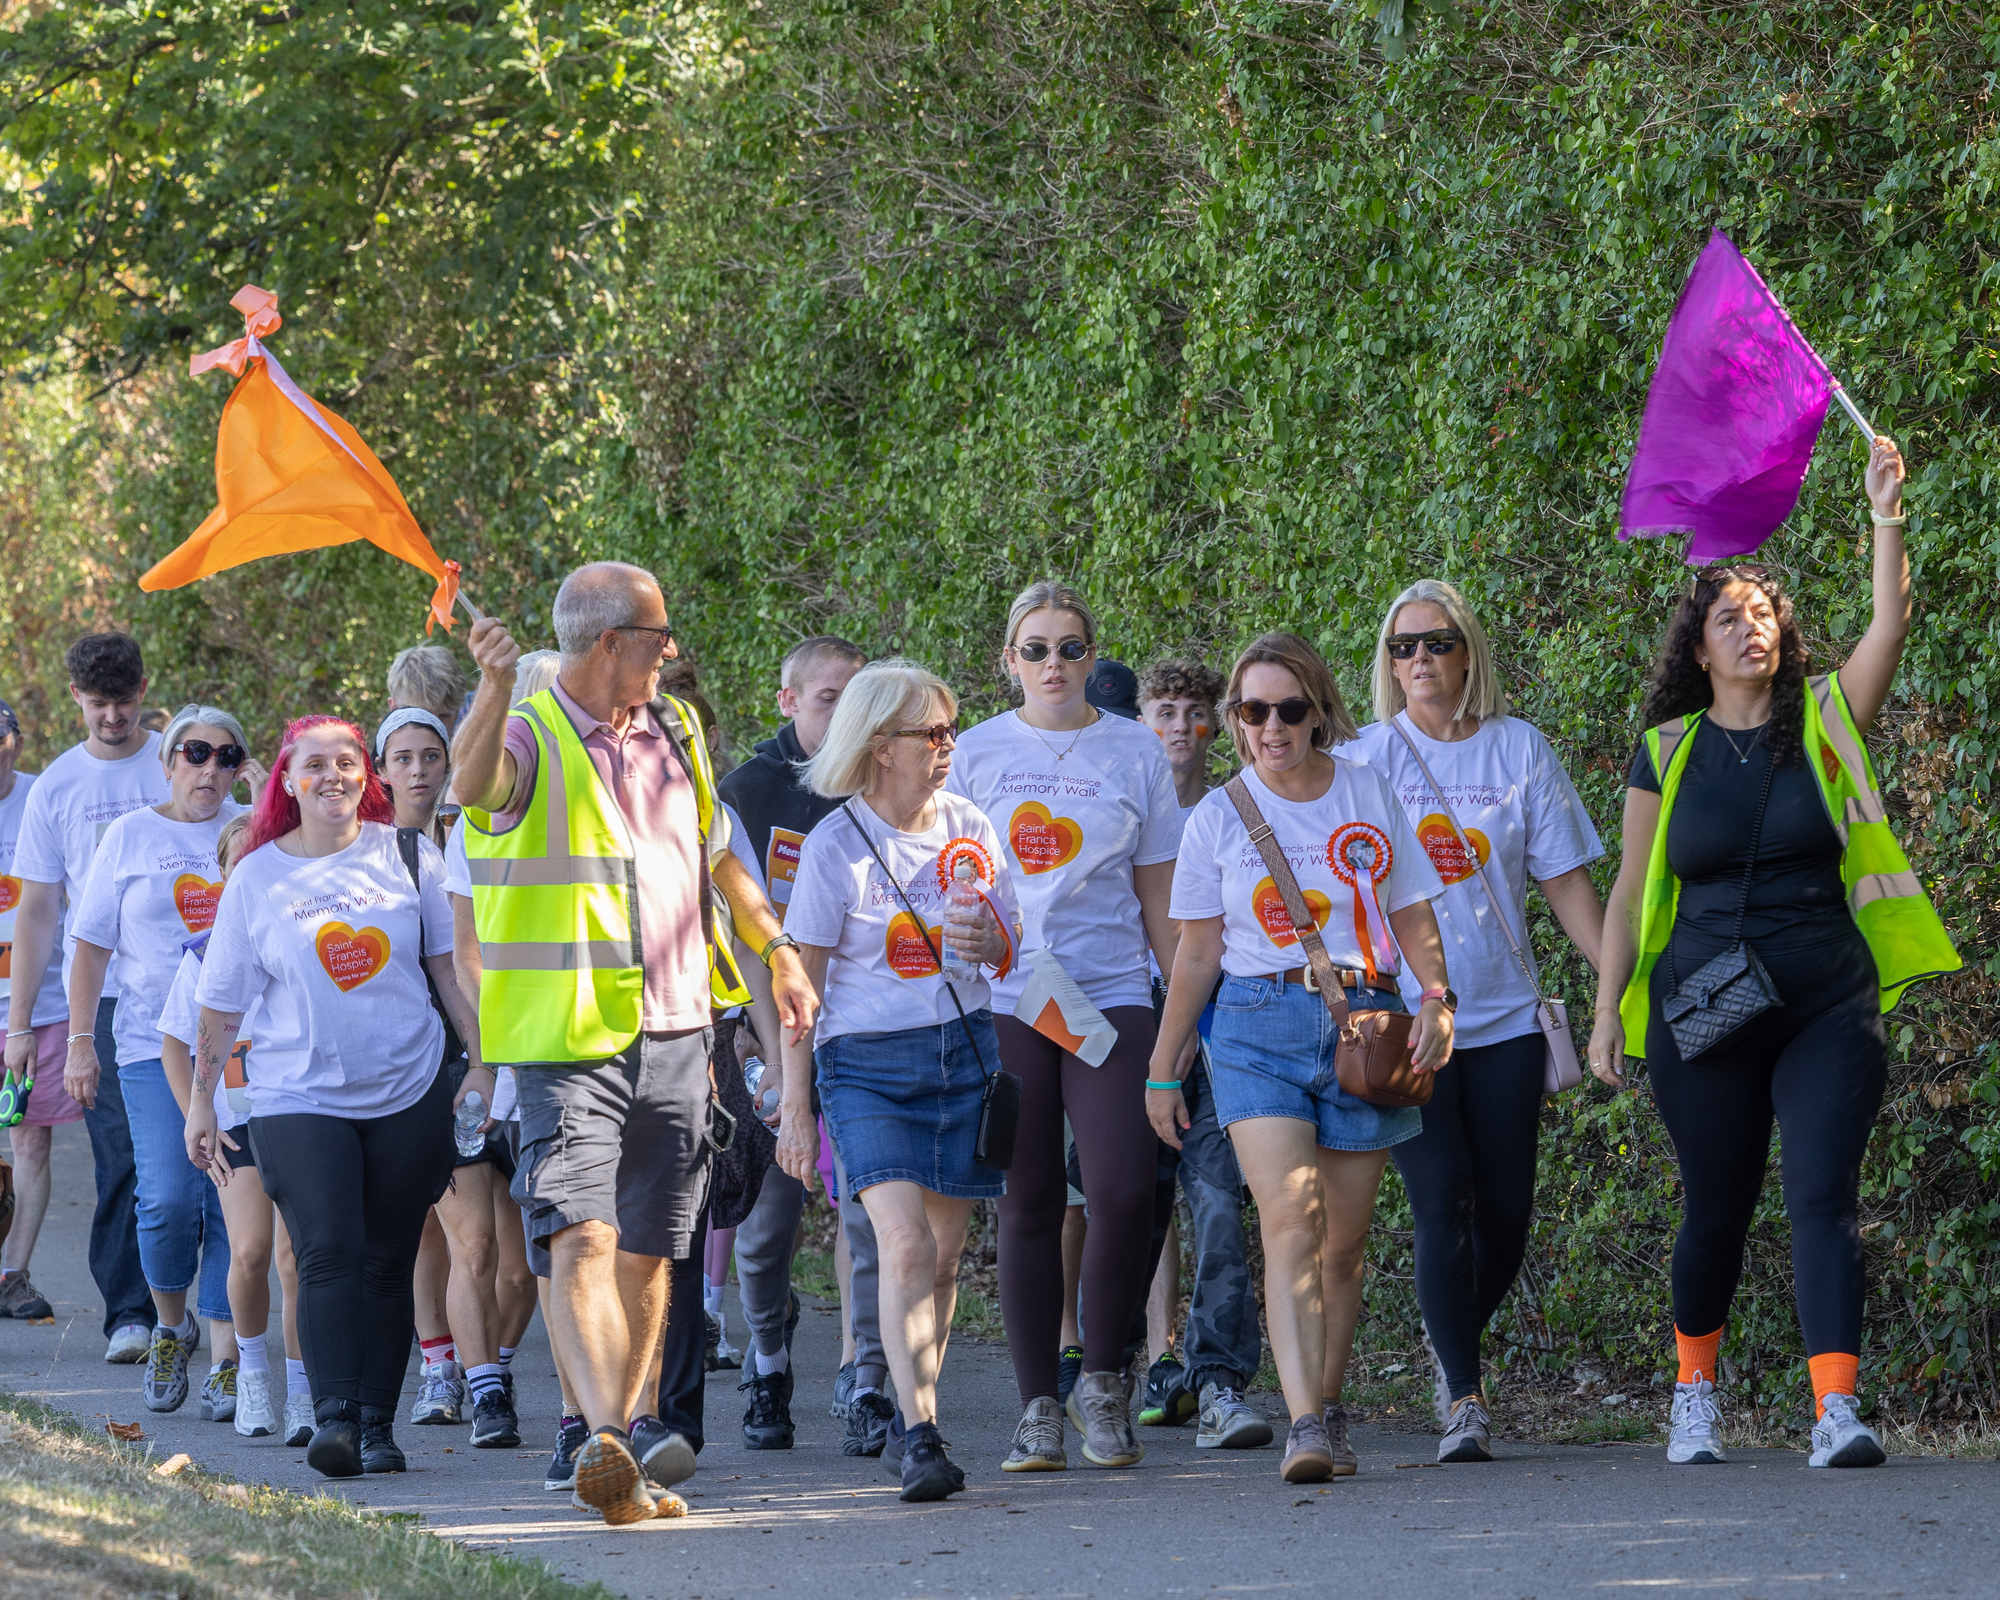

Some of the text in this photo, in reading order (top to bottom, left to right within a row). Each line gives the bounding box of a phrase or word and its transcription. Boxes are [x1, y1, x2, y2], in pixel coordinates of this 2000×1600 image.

[1002, 772, 1101, 788] Saint Francis Hospice
[1000, 784, 1100, 799] Memory Walk
[1402, 783, 1426, 793] Saint
[1464, 784, 1503, 794] Hospice
[103, 799, 129, 810] Francis
[1468, 793, 1503, 807] Walk
[1018, 823, 1047, 834] Saint
[1018, 834, 1057, 845] Francis
[1426, 834, 1454, 846] Saint
[1018, 844, 1061, 857] Hospice
[1426, 845, 1465, 857] Francis
[157, 852, 178, 863] Saint
[179, 851, 207, 861] Francis
[1020, 857, 1036, 865] Caring
[160, 859, 210, 871] Memory
[871, 880, 894, 891] Saint
[183, 888, 207, 898] Saint
[184, 895, 218, 907] Francis
[290, 899, 313, 909] Saint
[314, 891, 347, 904] Francis
[184, 905, 217, 915] Hospic
[294, 893, 389, 921] Memory Walk
[1264, 909, 1290, 919] Fran
[326, 940, 354, 953] Saint
[897, 935, 925, 946] Saint
[329, 948, 367, 964] Francis
[893, 954, 937, 964] Hospice
[331, 957, 374, 973] Hospice
[335, 974, 351, 983] Caring
